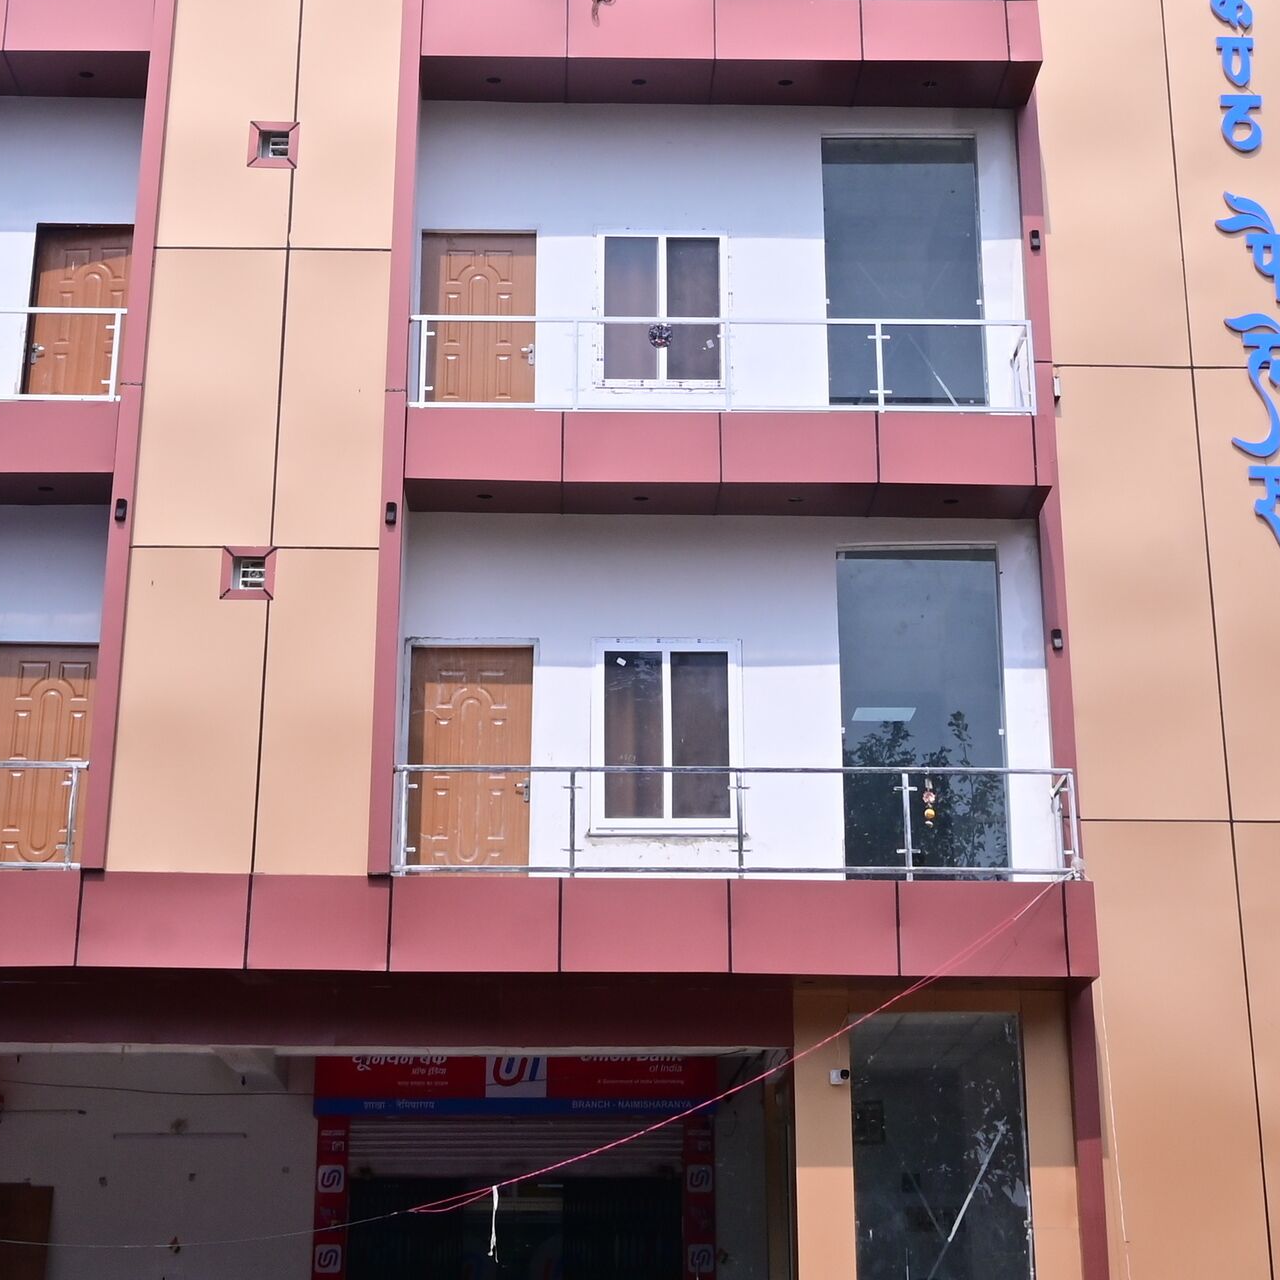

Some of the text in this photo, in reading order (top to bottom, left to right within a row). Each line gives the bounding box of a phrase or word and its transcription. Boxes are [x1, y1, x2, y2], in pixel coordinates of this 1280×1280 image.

[660, 1064, 683, 1073] India
[572, 1100, 610, 1109] BRANCH
[618, 1099, 691, 1109] NAIMISHARANYA
